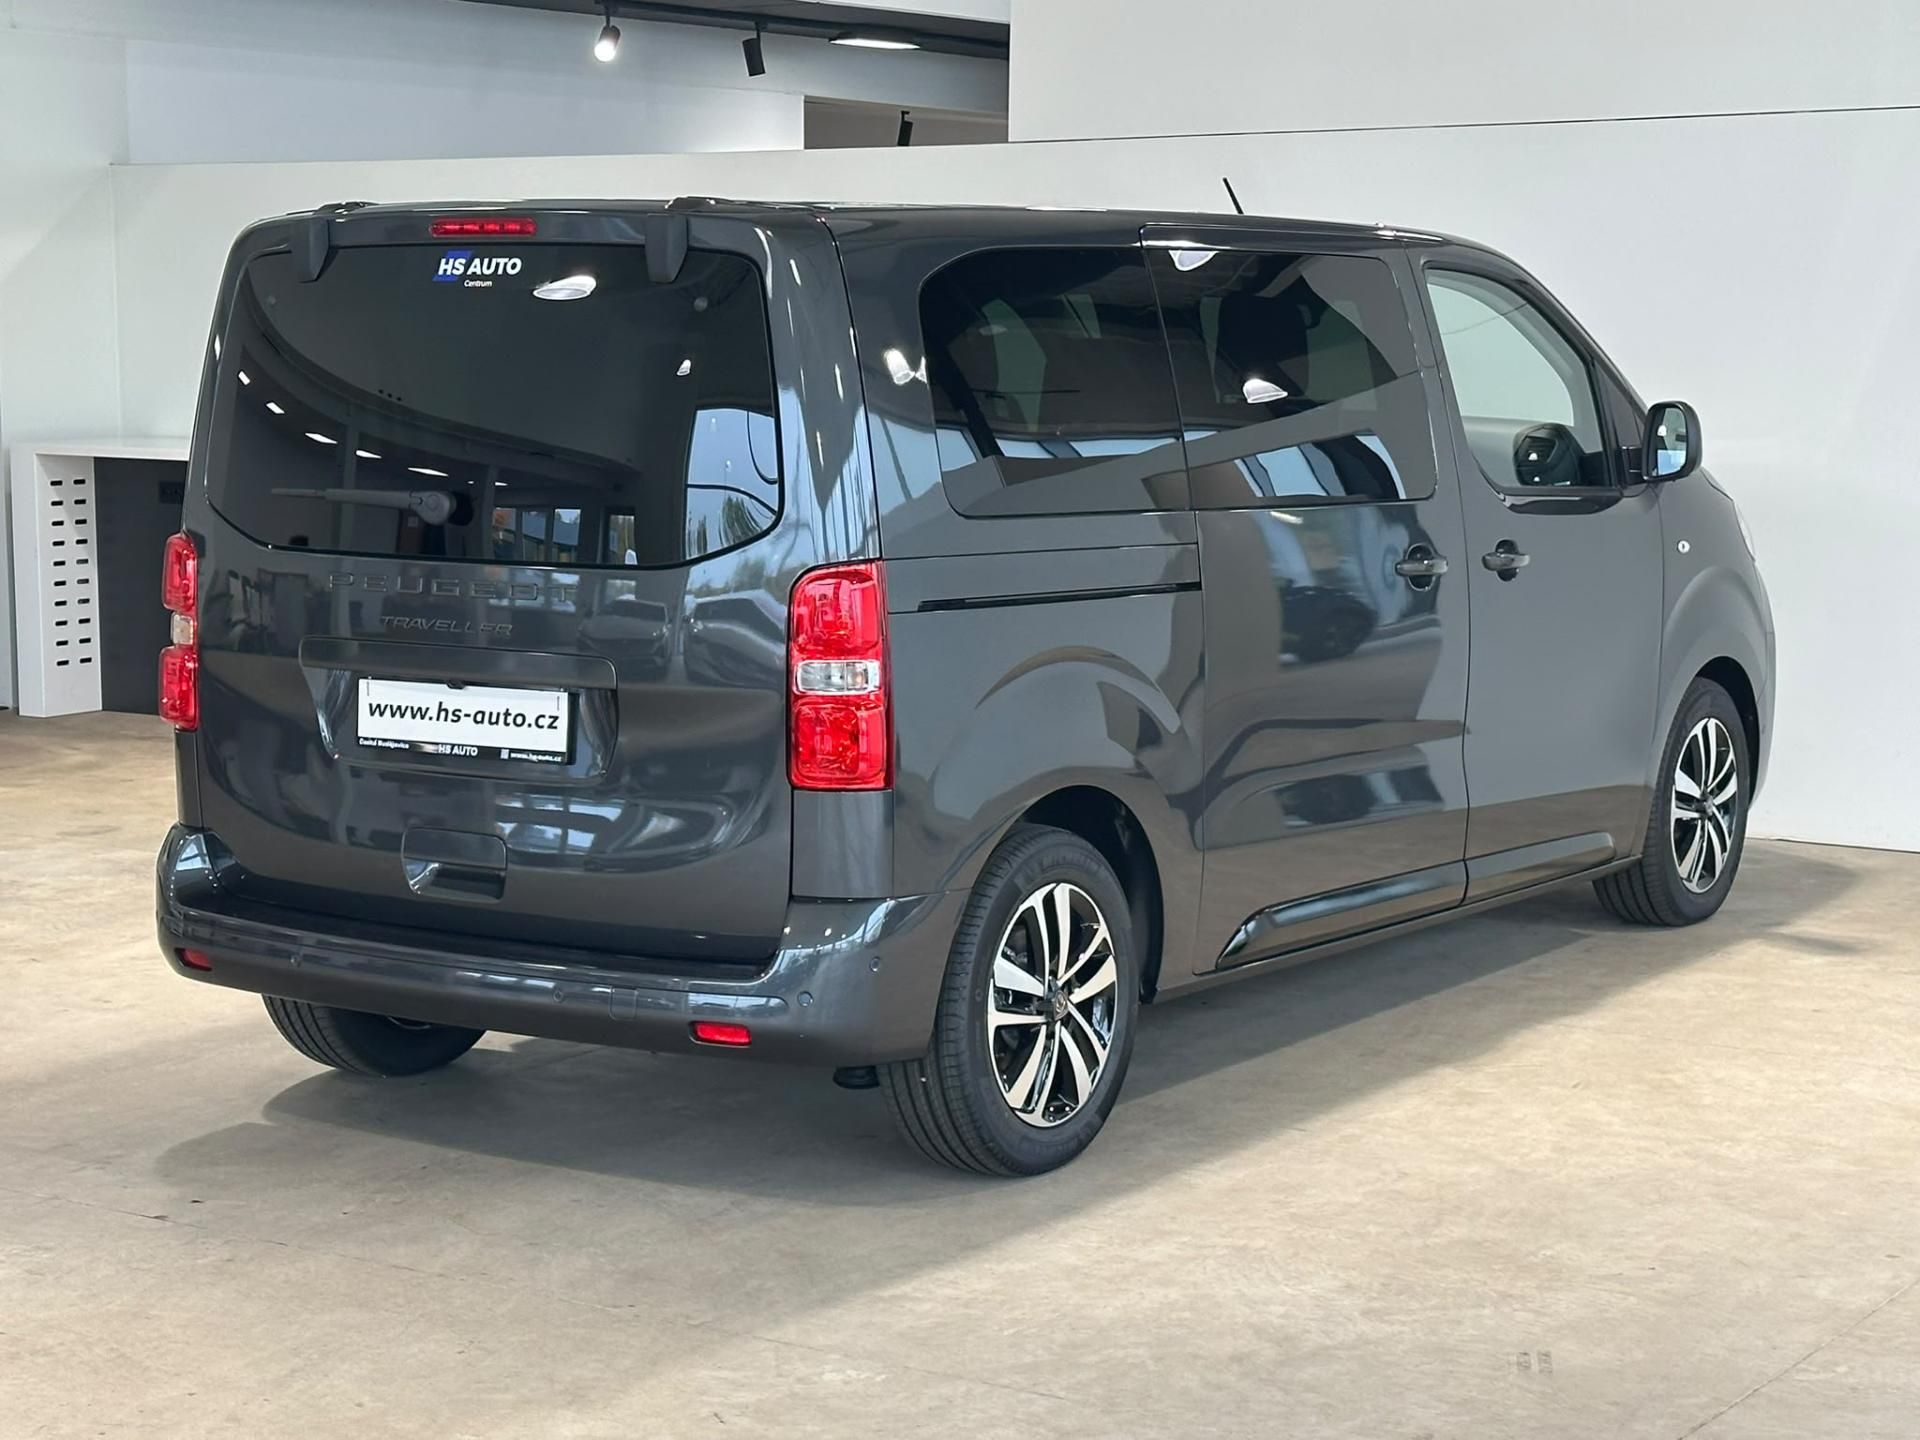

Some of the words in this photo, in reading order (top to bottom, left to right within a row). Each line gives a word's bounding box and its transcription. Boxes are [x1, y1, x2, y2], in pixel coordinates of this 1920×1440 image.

[438, 258, 466, 275] HS
[467, 258, 522, 275] AUTO
[463, 279, 493, 287] Centrum
[329, 572, 578, 602] PEUGEOT
[381, 615, 513, 637] TRAVELLER
[368, 701, 560, 730] www.hs-auto.cz
[438, 743, 451, 754] HS
[452, 745, 478, 756] AUTO
